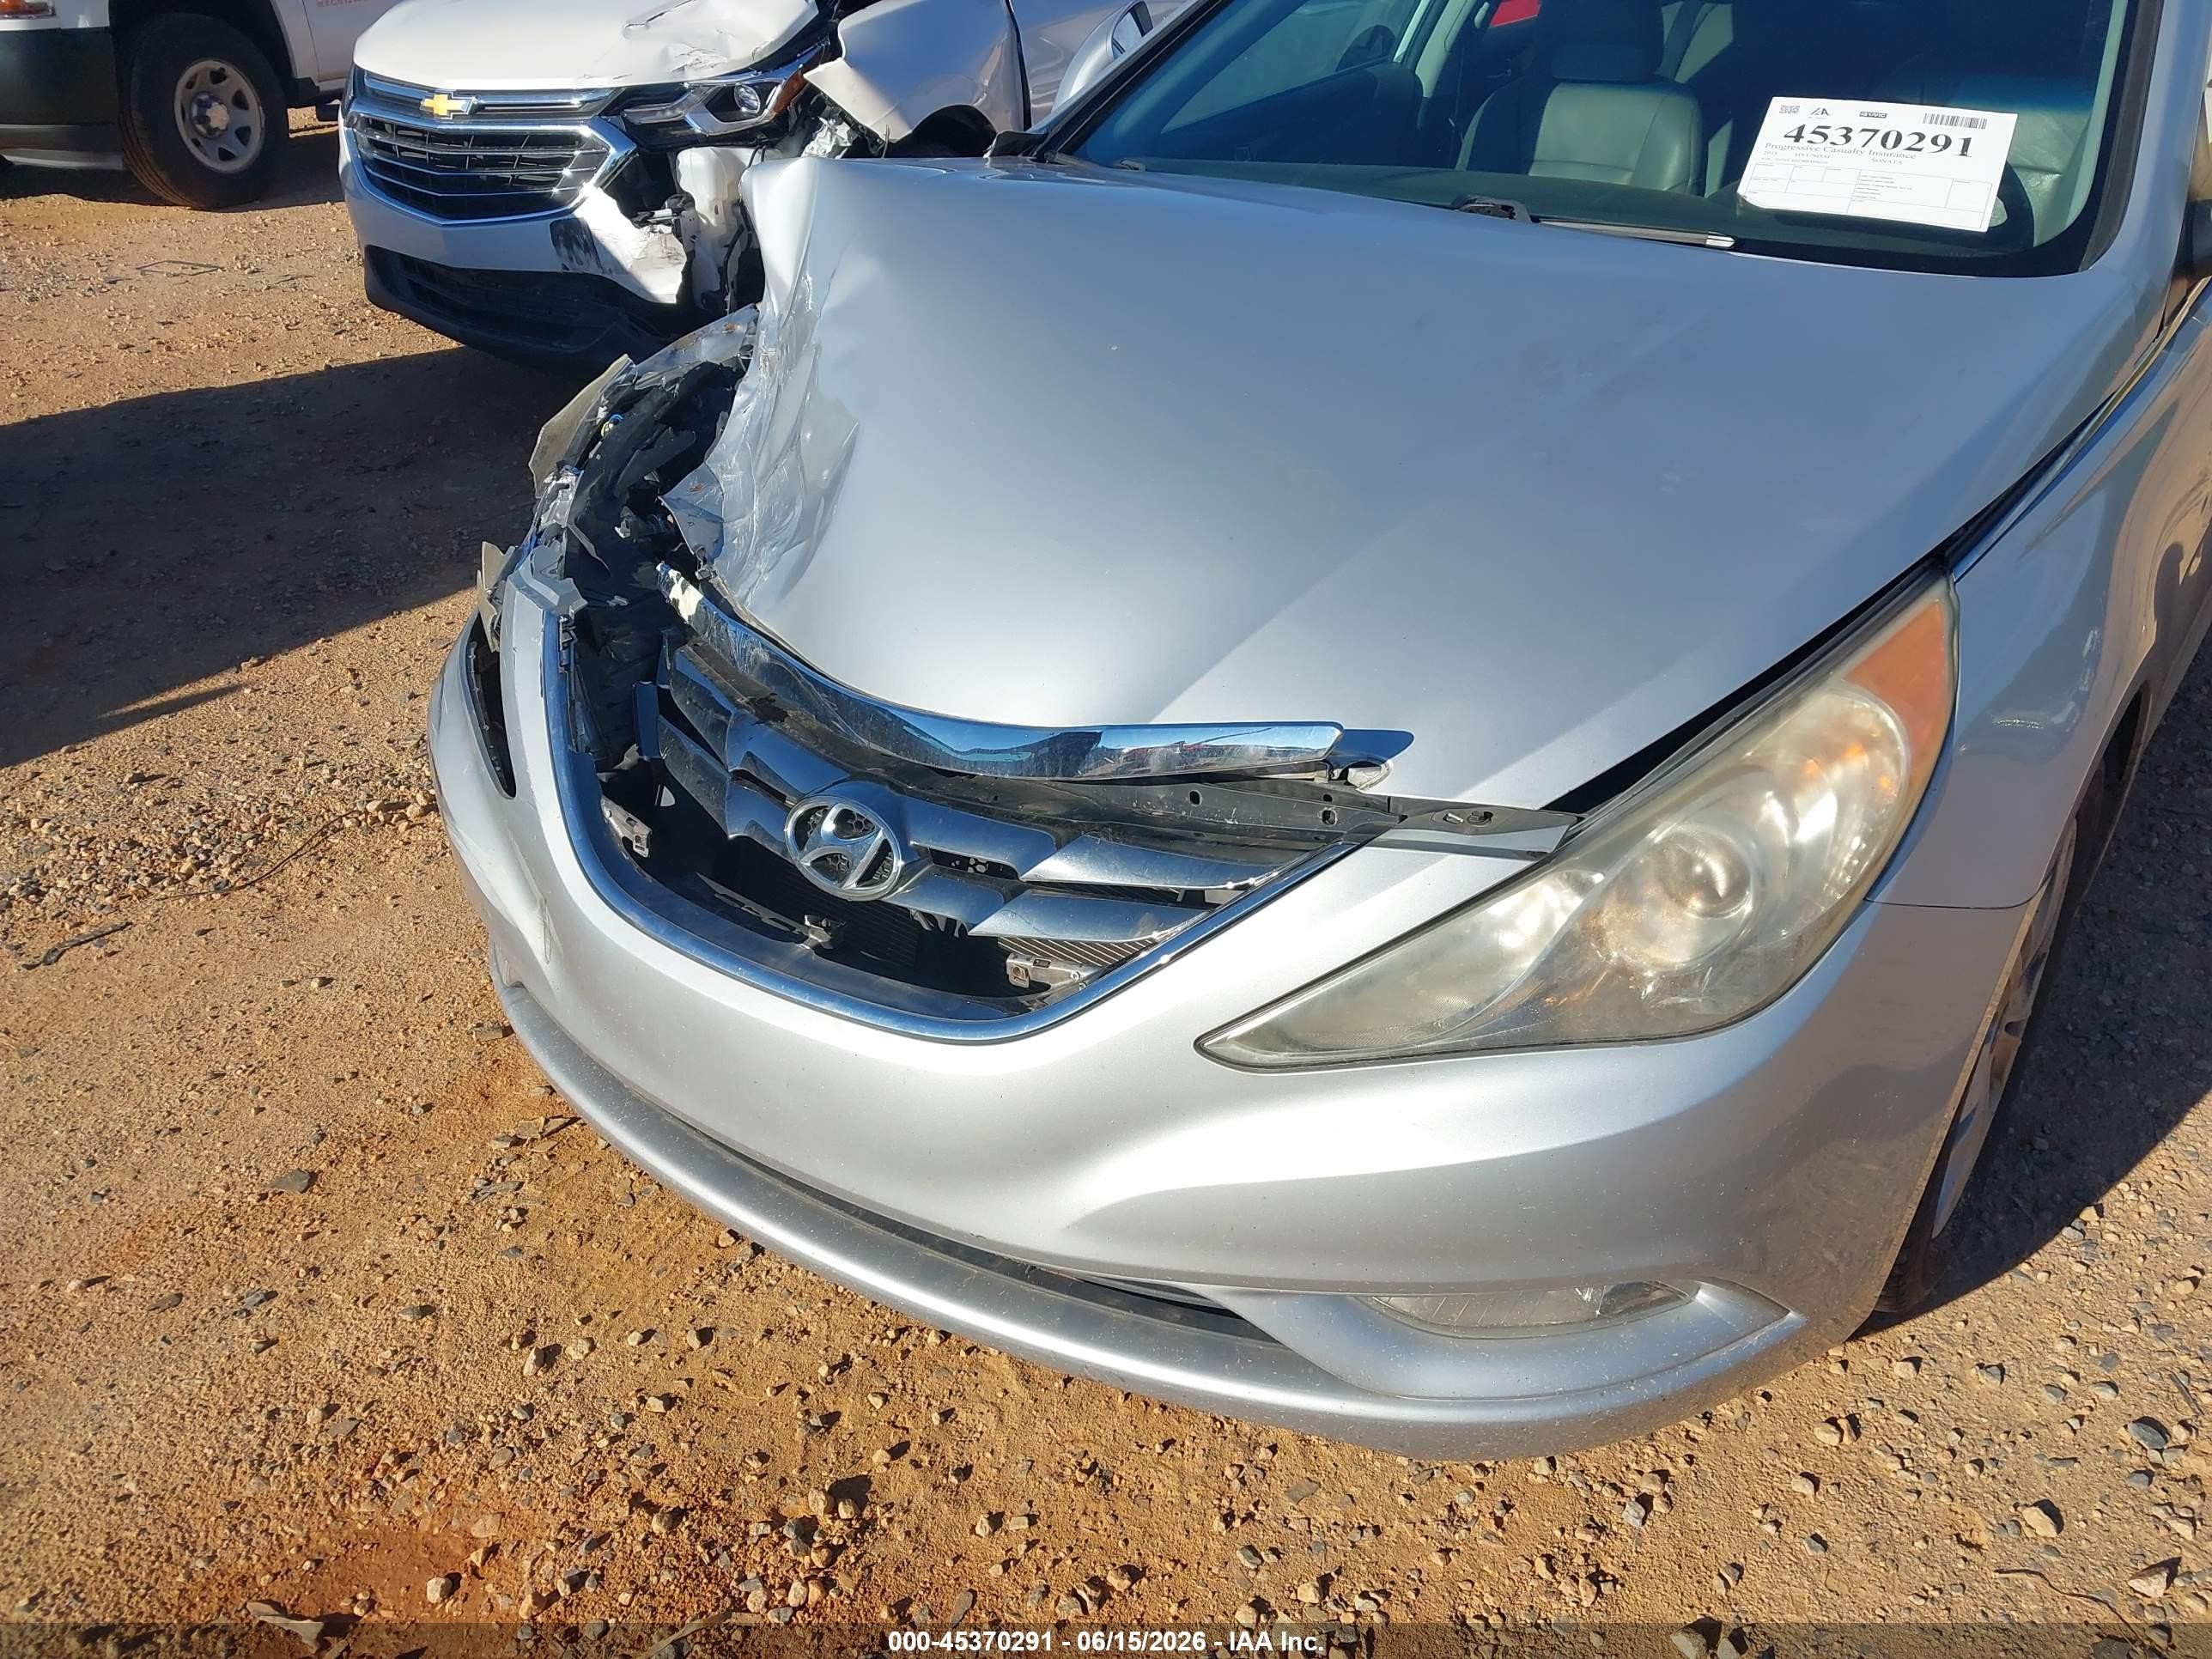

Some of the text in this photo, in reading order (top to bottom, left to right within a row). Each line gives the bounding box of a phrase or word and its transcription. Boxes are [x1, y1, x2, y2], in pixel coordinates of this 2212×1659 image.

[1765, 143, 1917, 160] Progressive Casualty Insurance
[1784, 124, 1972, 157] 45370291
